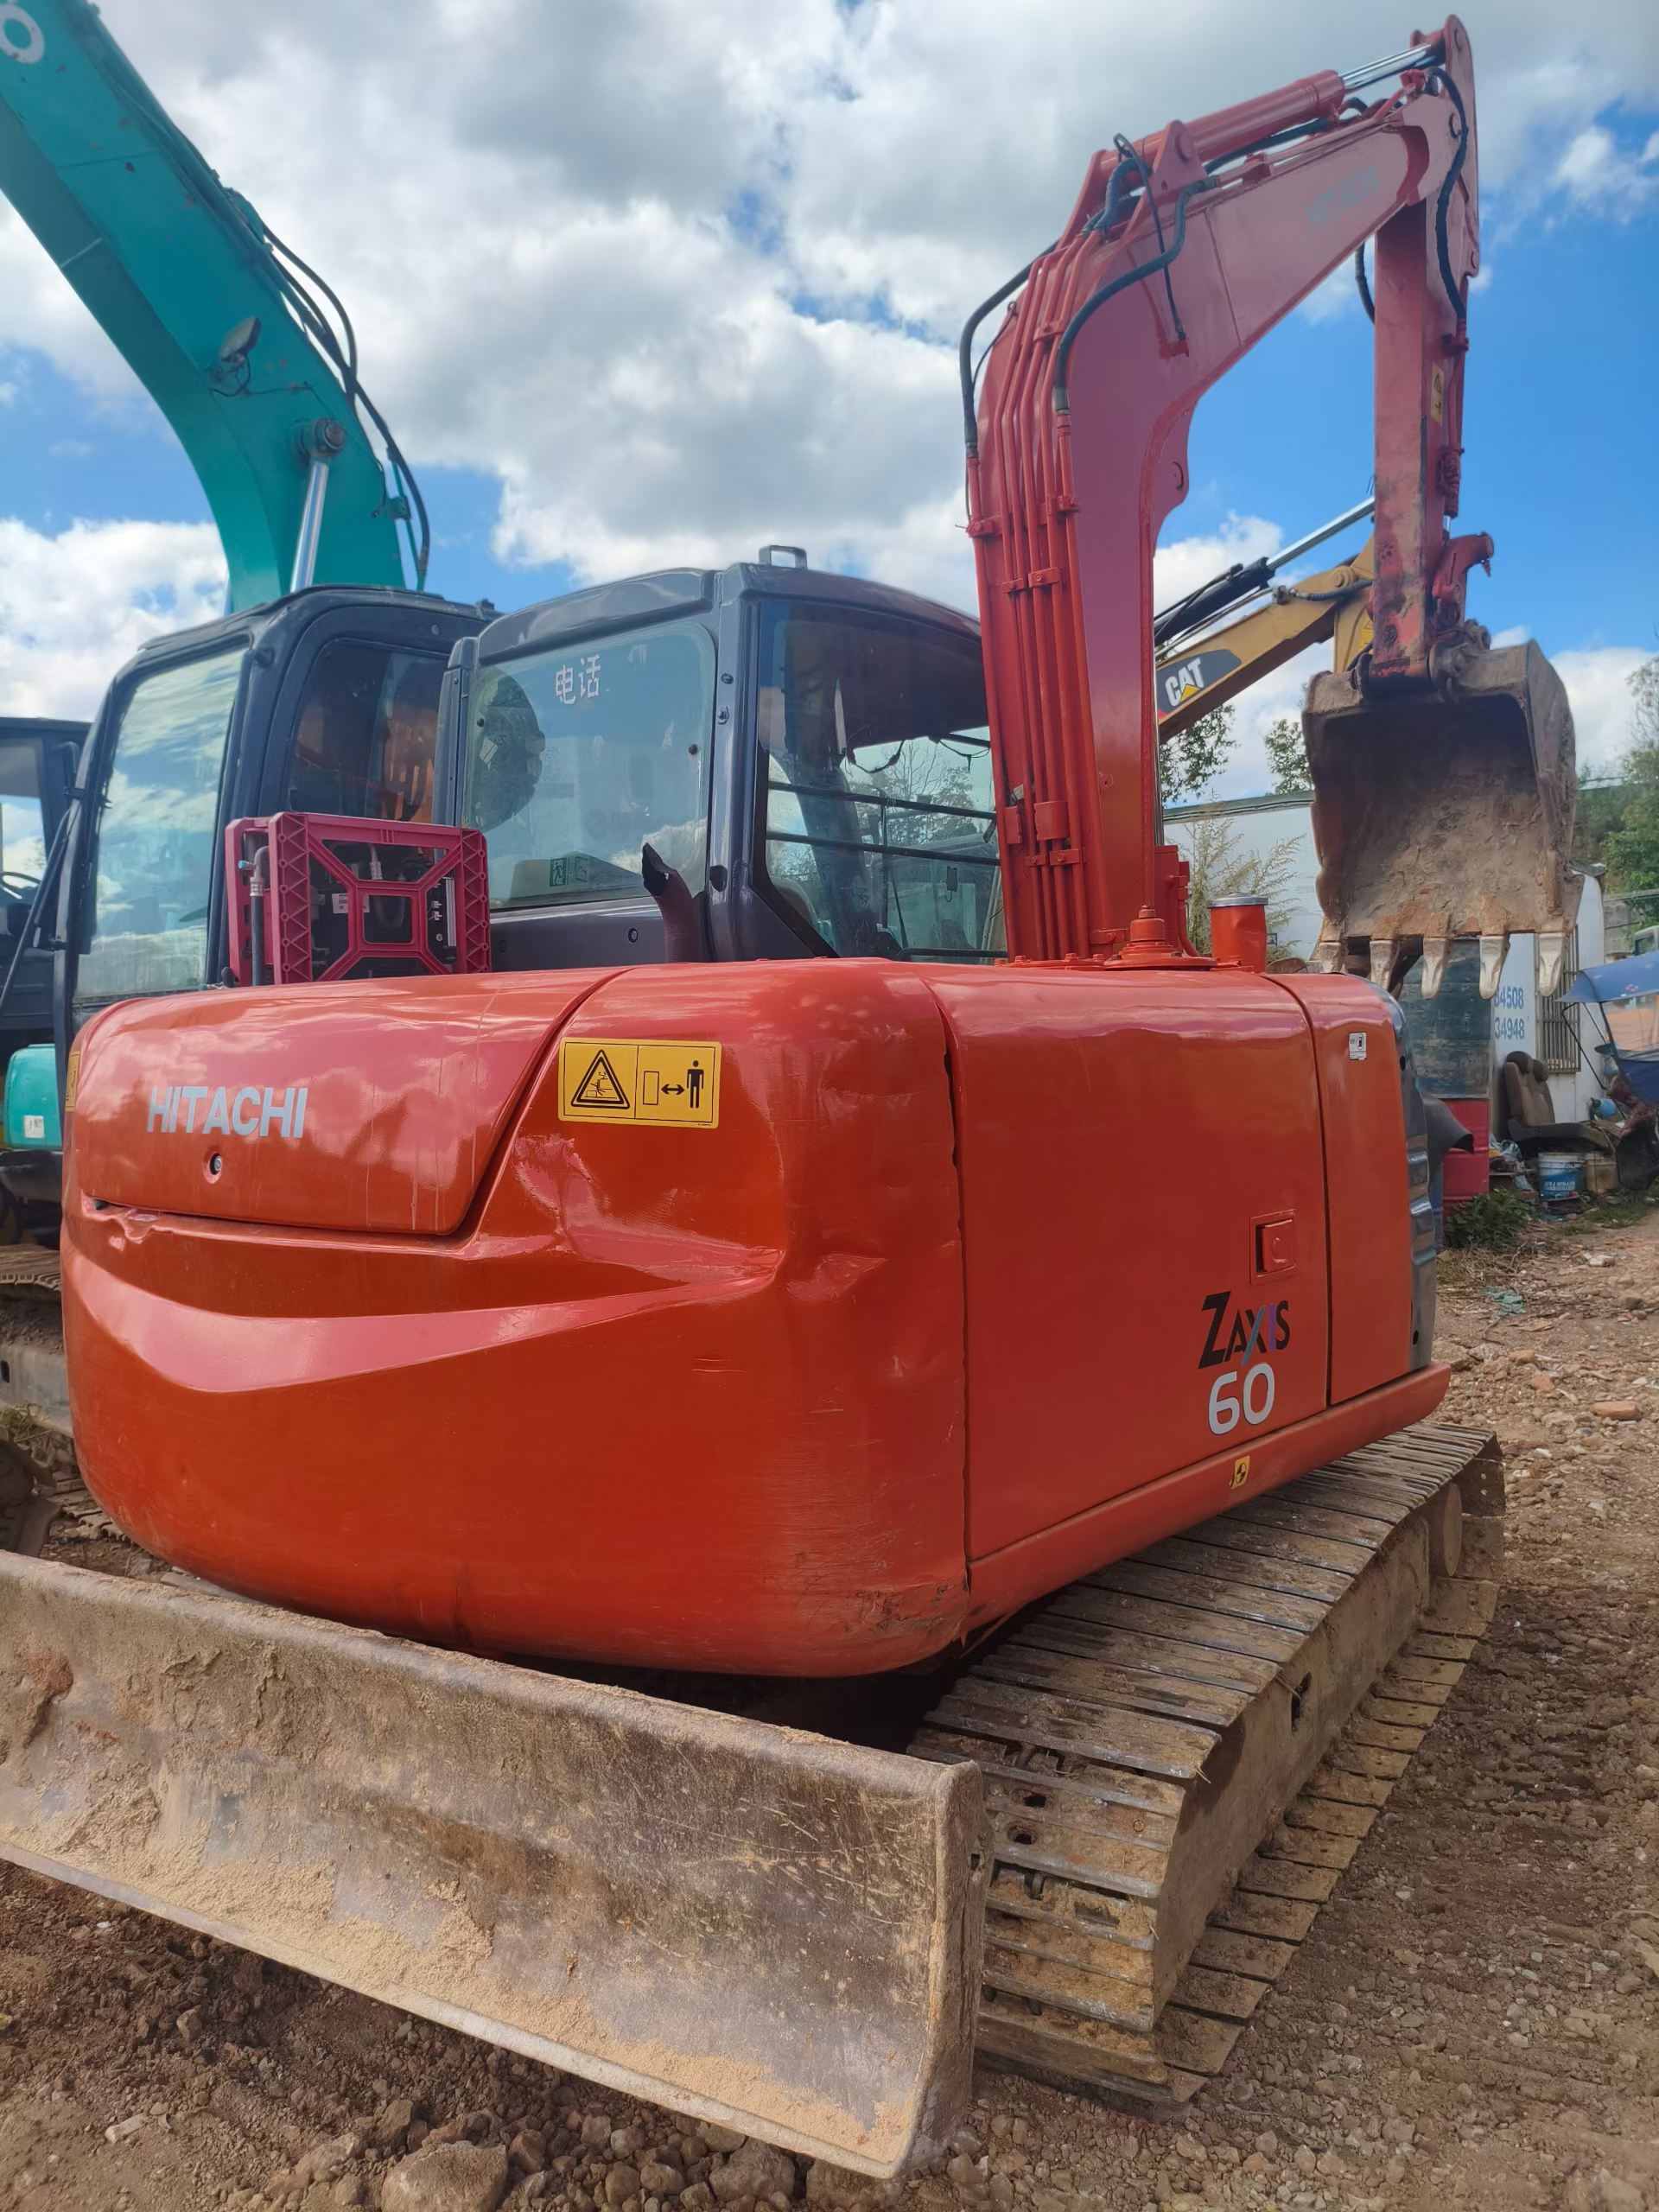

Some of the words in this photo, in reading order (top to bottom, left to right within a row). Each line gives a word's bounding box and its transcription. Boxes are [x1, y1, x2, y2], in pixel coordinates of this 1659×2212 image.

[556, 654, 601, 705] 电话
[1165, 657, 1205, 707] CAT
[146, 1085, 308, 1139] HITACHI
[1198, 1291, 1291, 1370] ZAXIS
[1208, 1362, 1275, 1435] 60
